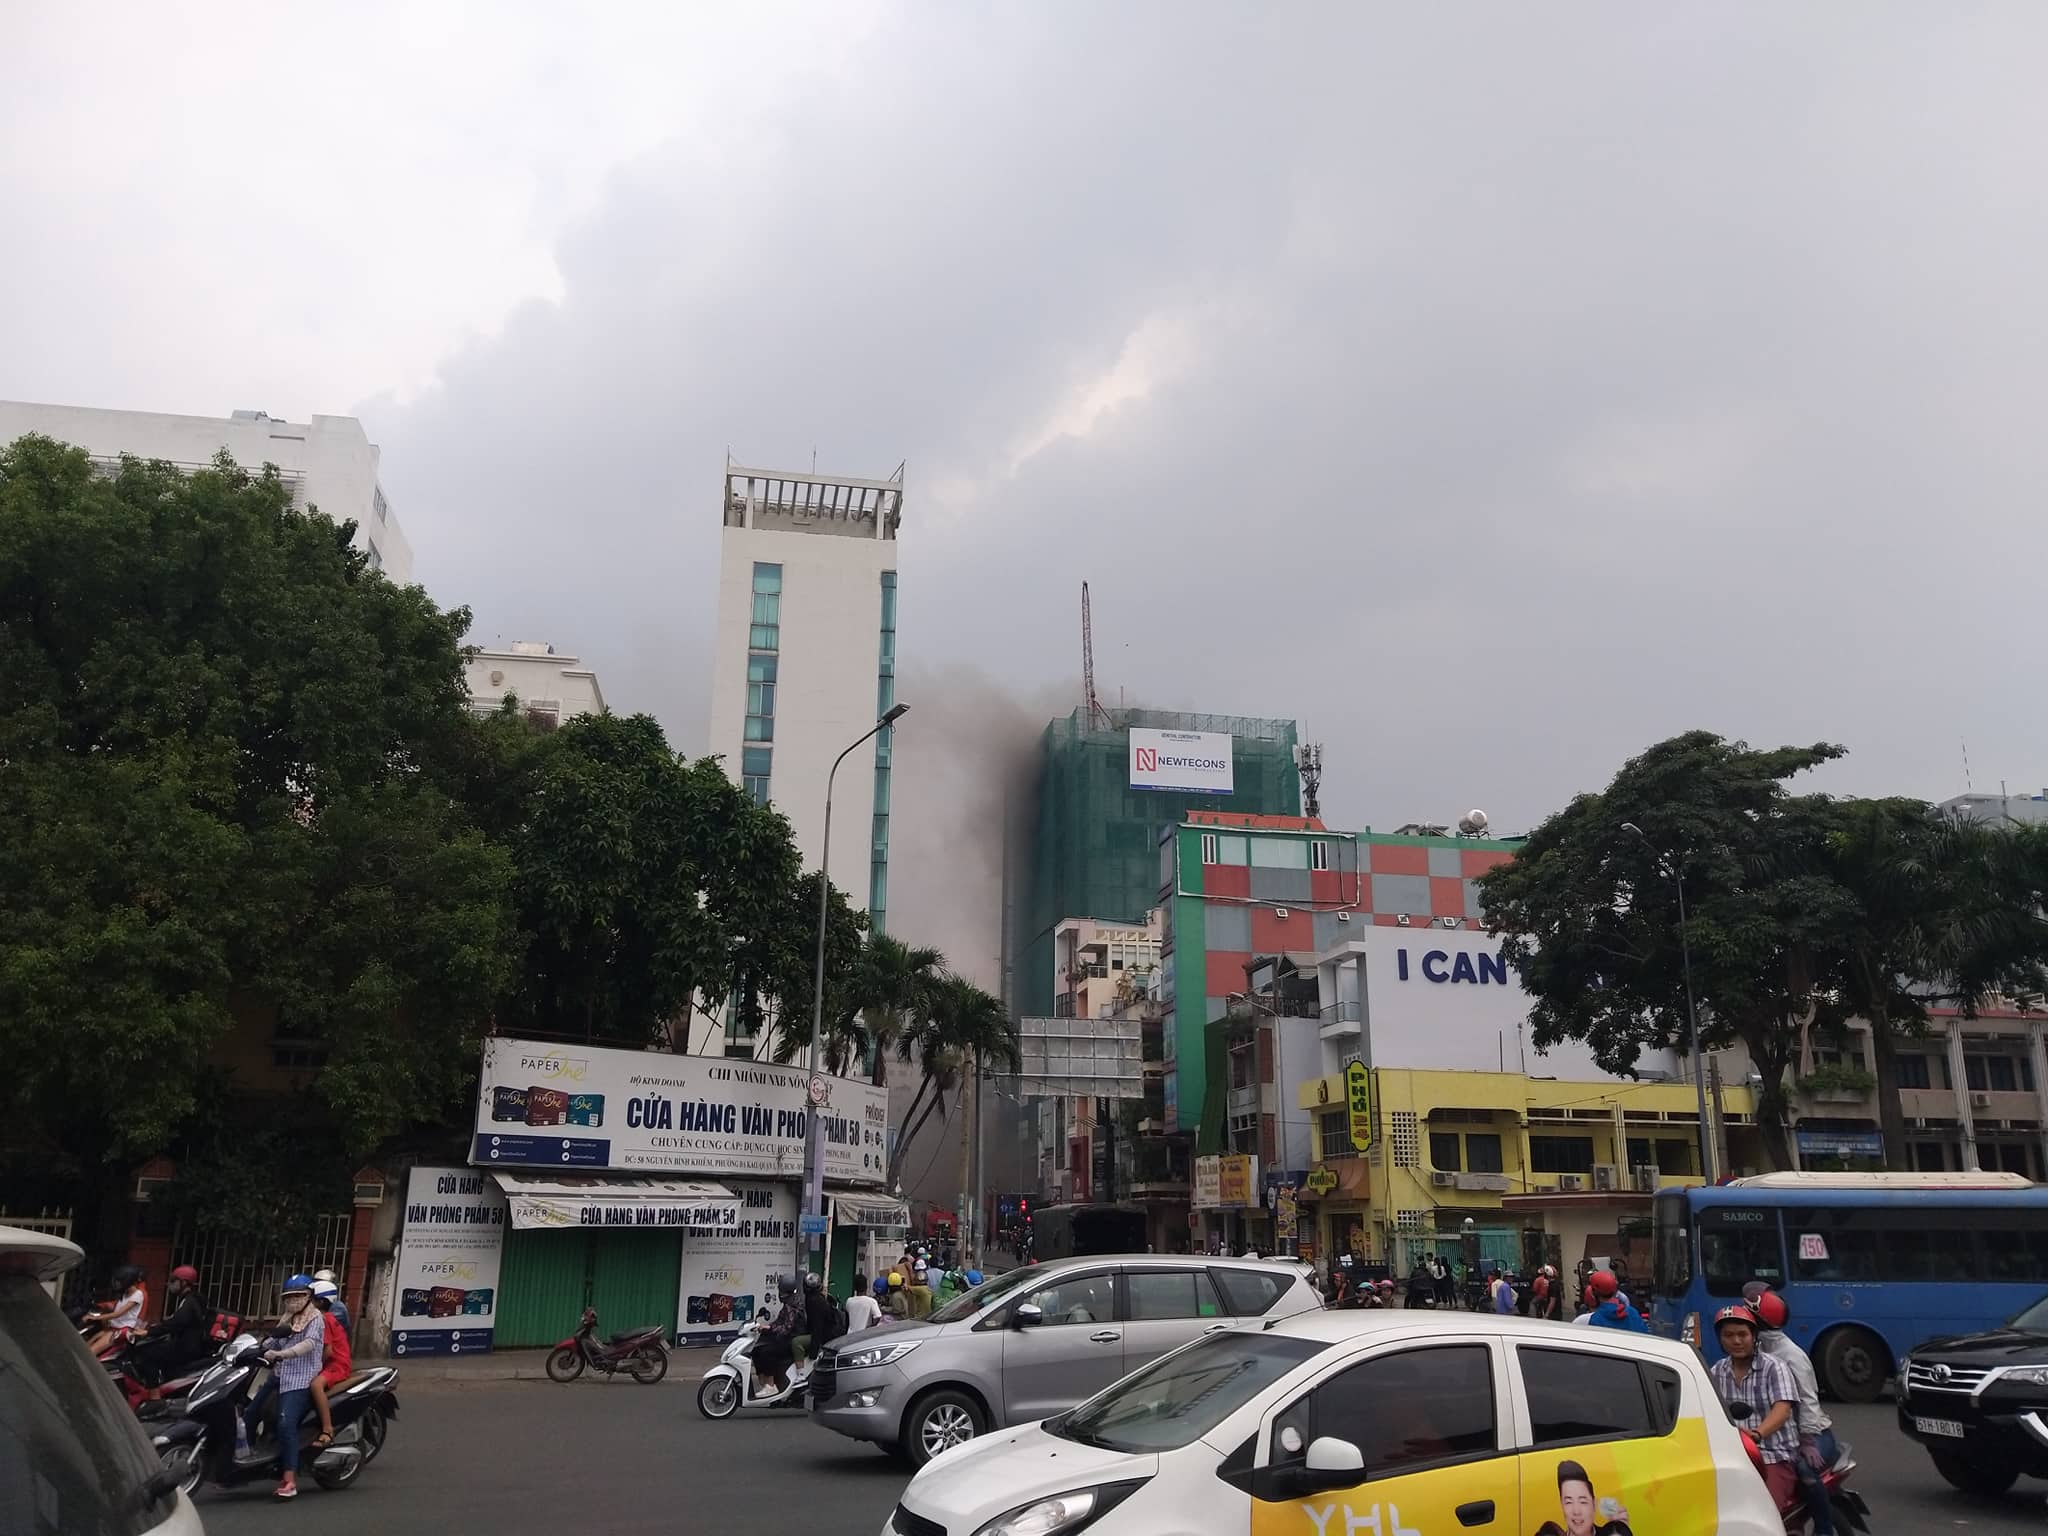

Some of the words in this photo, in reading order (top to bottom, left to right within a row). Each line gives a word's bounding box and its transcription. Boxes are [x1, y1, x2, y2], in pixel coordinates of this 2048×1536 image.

[1158, 756, 1226, 769] NEWTECONS
[1397, 948, 1409, 981] I
[1422, 950, 1508, 985] CAN
[521, 1058, 560, 1072] PAPER
[642, 1076, 660, 1086] KINH
[709, 1067, 731, 1081] CHI
[734, 1067, 766, 1085] NHÁNH
[626, 1091, 673, 1130] CỬA
[680, 1097, 737, 1134] HÀNG
[741, 1102, 773, 1137] VĂN
[849, 1120, 860, 1147] 58
[651, 1136, 692, 1148] CHUYÊN
[695, 1139, 722, 1150] CUNG
[437, 1172, 456, 1194] CỬA
[408, 1202, 428, 1223] VĂN
[429, 1203, 462, 1224] PHÒNG
[463, 1200, 490, 1225] PHẨM
[517, 1208, 547, 1218] PAPER
[580, 1203, 602, 1225] CỬA
[605, 1204, 633, 1225] HÀNG
[636, 1205, 656, 1225] VĂN
[658, 1206, 691, 1225] PHÒNG
[693, 1202, 721, 1225] PHẨM
[723, 1208, 736, 1225] 58
[1722, 1212, 1763, 1222] SAMCO
[754, 1214, 781, 1238] PHẨM
[783, 1221, 795, 1238] 58
[1801, 1238, 1825, 1257] 150
[421, 1264, 455, 1274] PAPER
[704, 1271, 729, 1281] PAPER
